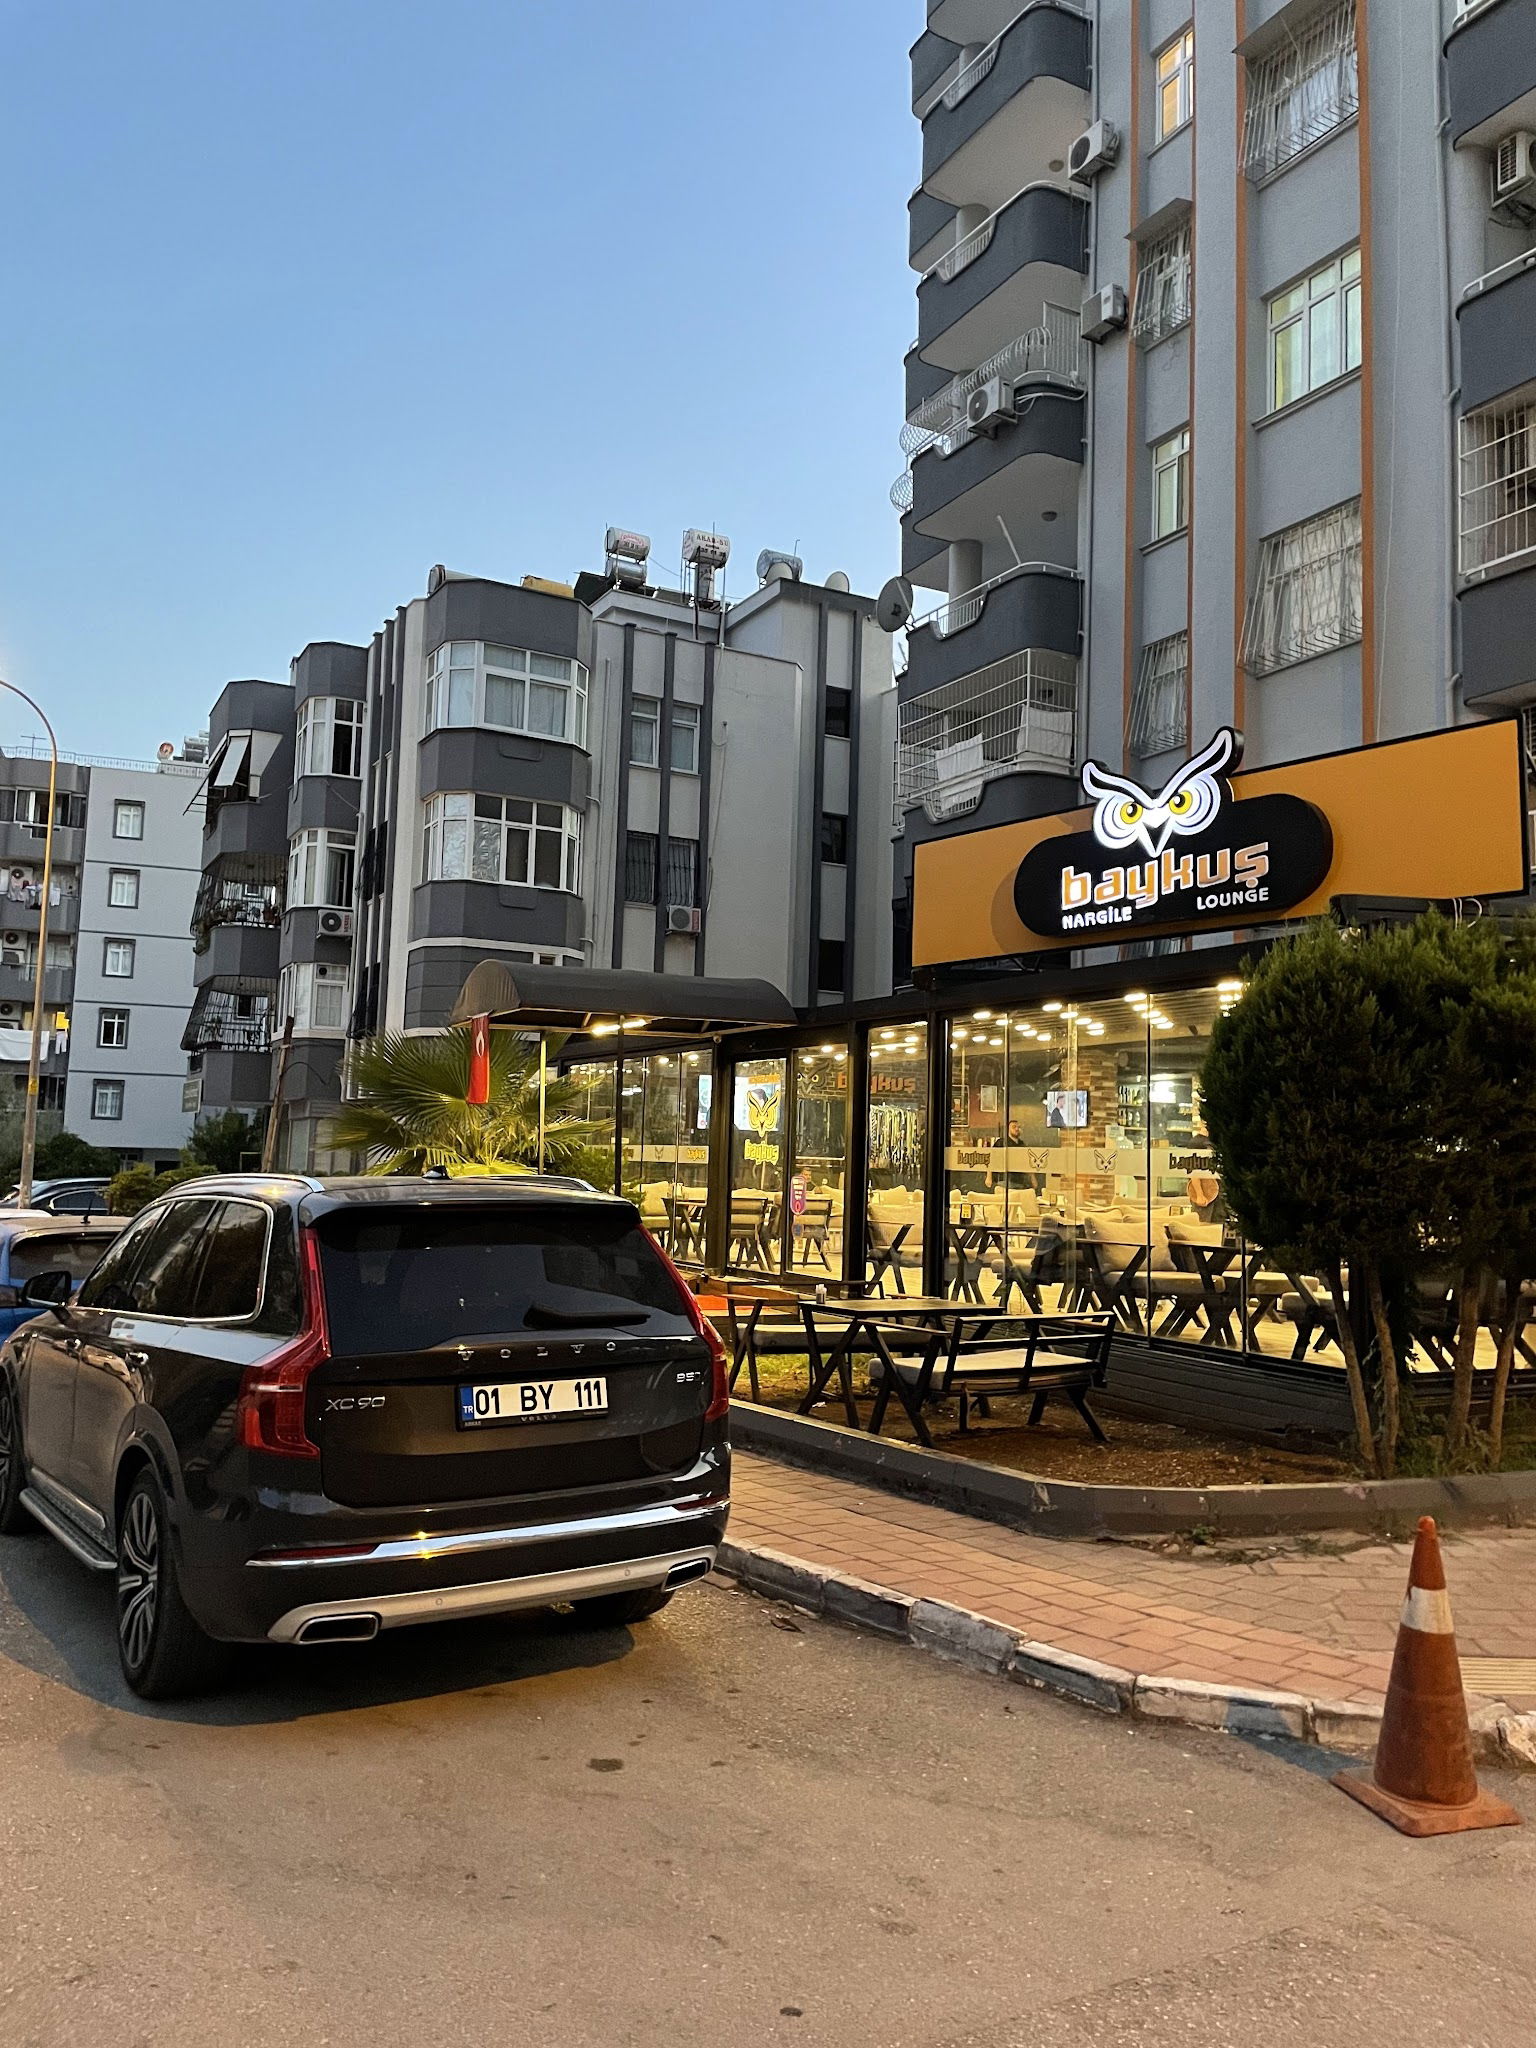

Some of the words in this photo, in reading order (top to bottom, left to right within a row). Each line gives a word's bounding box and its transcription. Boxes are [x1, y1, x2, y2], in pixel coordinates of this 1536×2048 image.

[1061, 841, 1270, 910] baykuş
[1196, 887, 1270, 910] LOUNGE
[1061, 905, 1133, 929] NARGİLE
[458, 1341, 617, 1361] VOLVO
[475, 1387, 500, 1415] 01
[520, 1384, 554, 1412] BY
[574, 1380, 602, 1408] 111
[462, 1405, 474, 1414] TR
